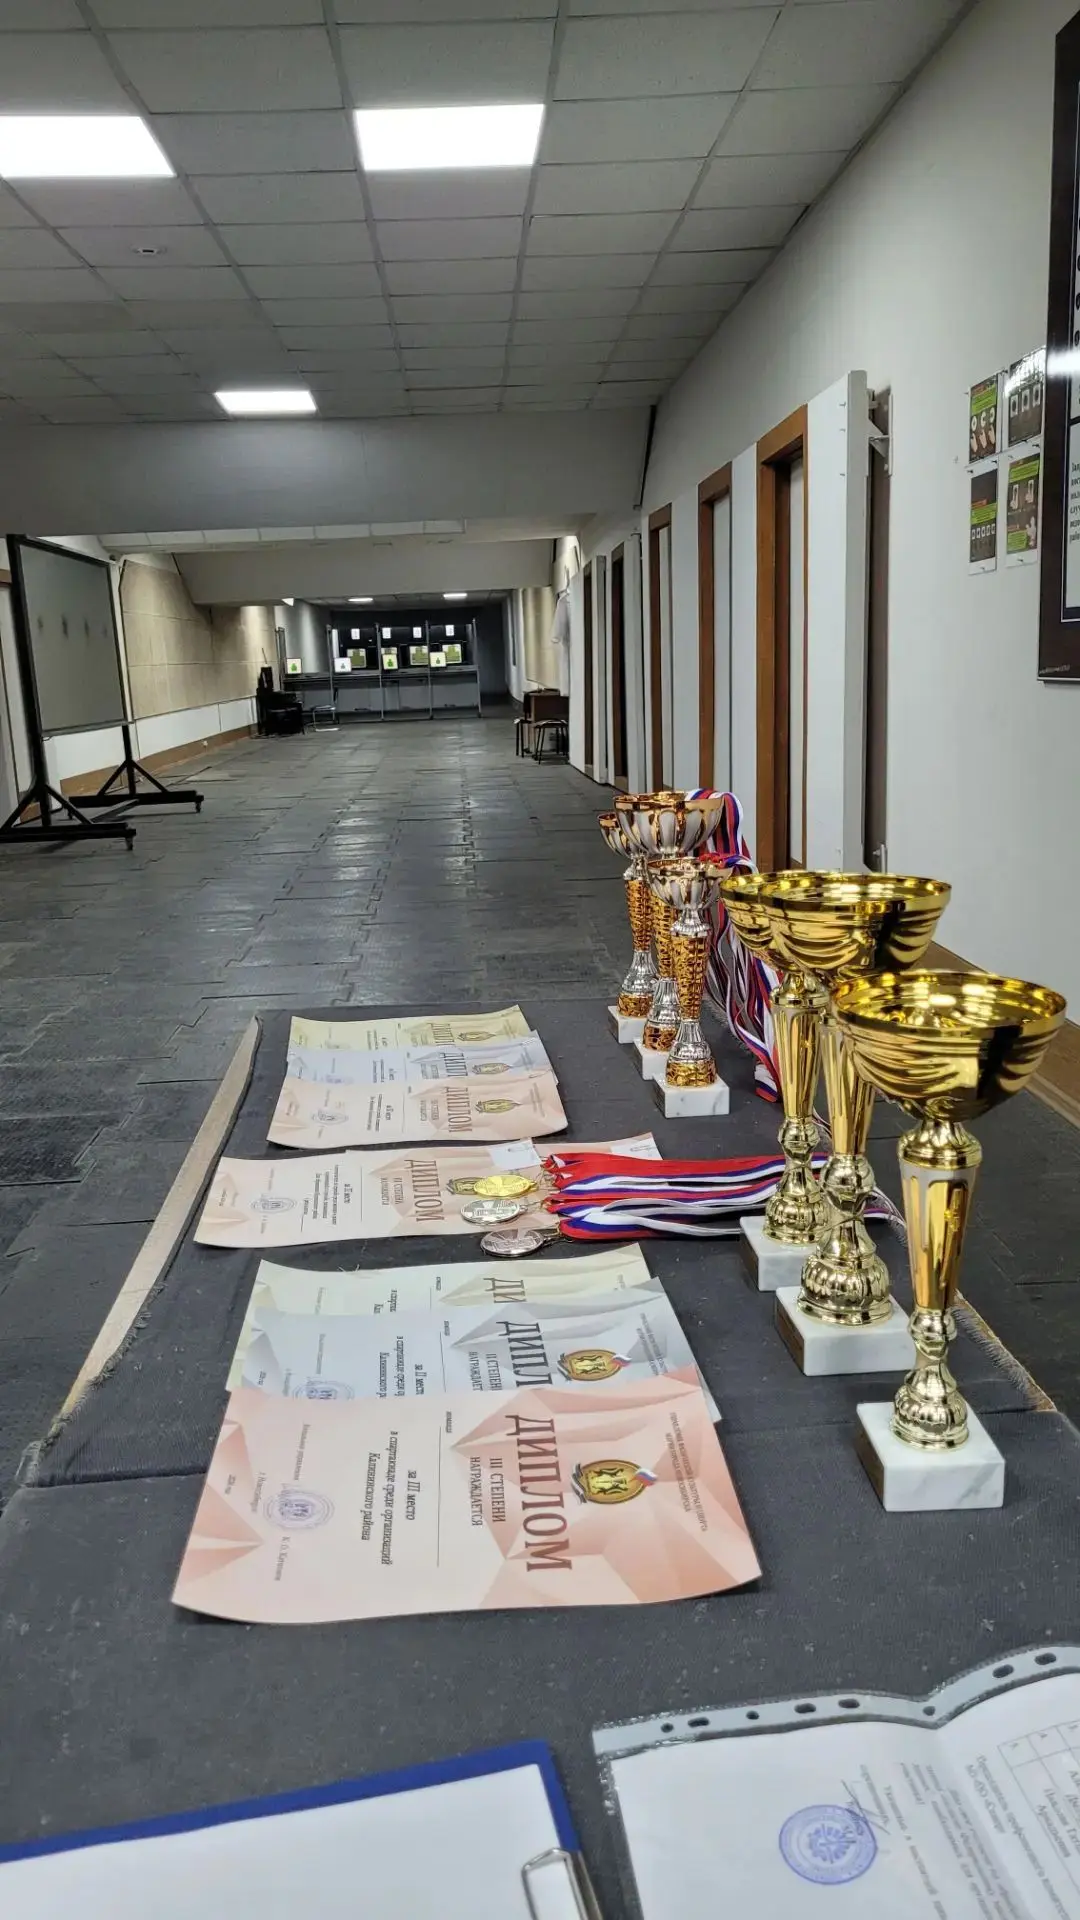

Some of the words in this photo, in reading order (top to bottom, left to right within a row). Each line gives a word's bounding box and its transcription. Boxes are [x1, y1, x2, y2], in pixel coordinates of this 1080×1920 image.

[443, 1087, 473, 1133] ДИПЛОМ
[404, 1159, 445, 1222] ДИПЛОМ
[495, 1321, 553, 1388] ДИПЛ
[363, 1452, 381, 1509] Калининского
[383, 1436, 399, 1483] спартакиаде
[407, 1470, 417, 1479] за
[489, 1457, 503, 1469] III
[382, 1483, 397, 1508] среди
[405, 1493, 417, 1520] место
[406, 1481, 421, 1492] III
[469, 1457, 483, 1527] НАГРАЖДАЕТСЯ
[489, 1473, 506, 1523] СТЕПЕНИ
[505, 1415, 573, 1572] ДИПЛОМ
[359, 1510, 375, 1541] района
[380, 1509, 394, 1565] организаций
